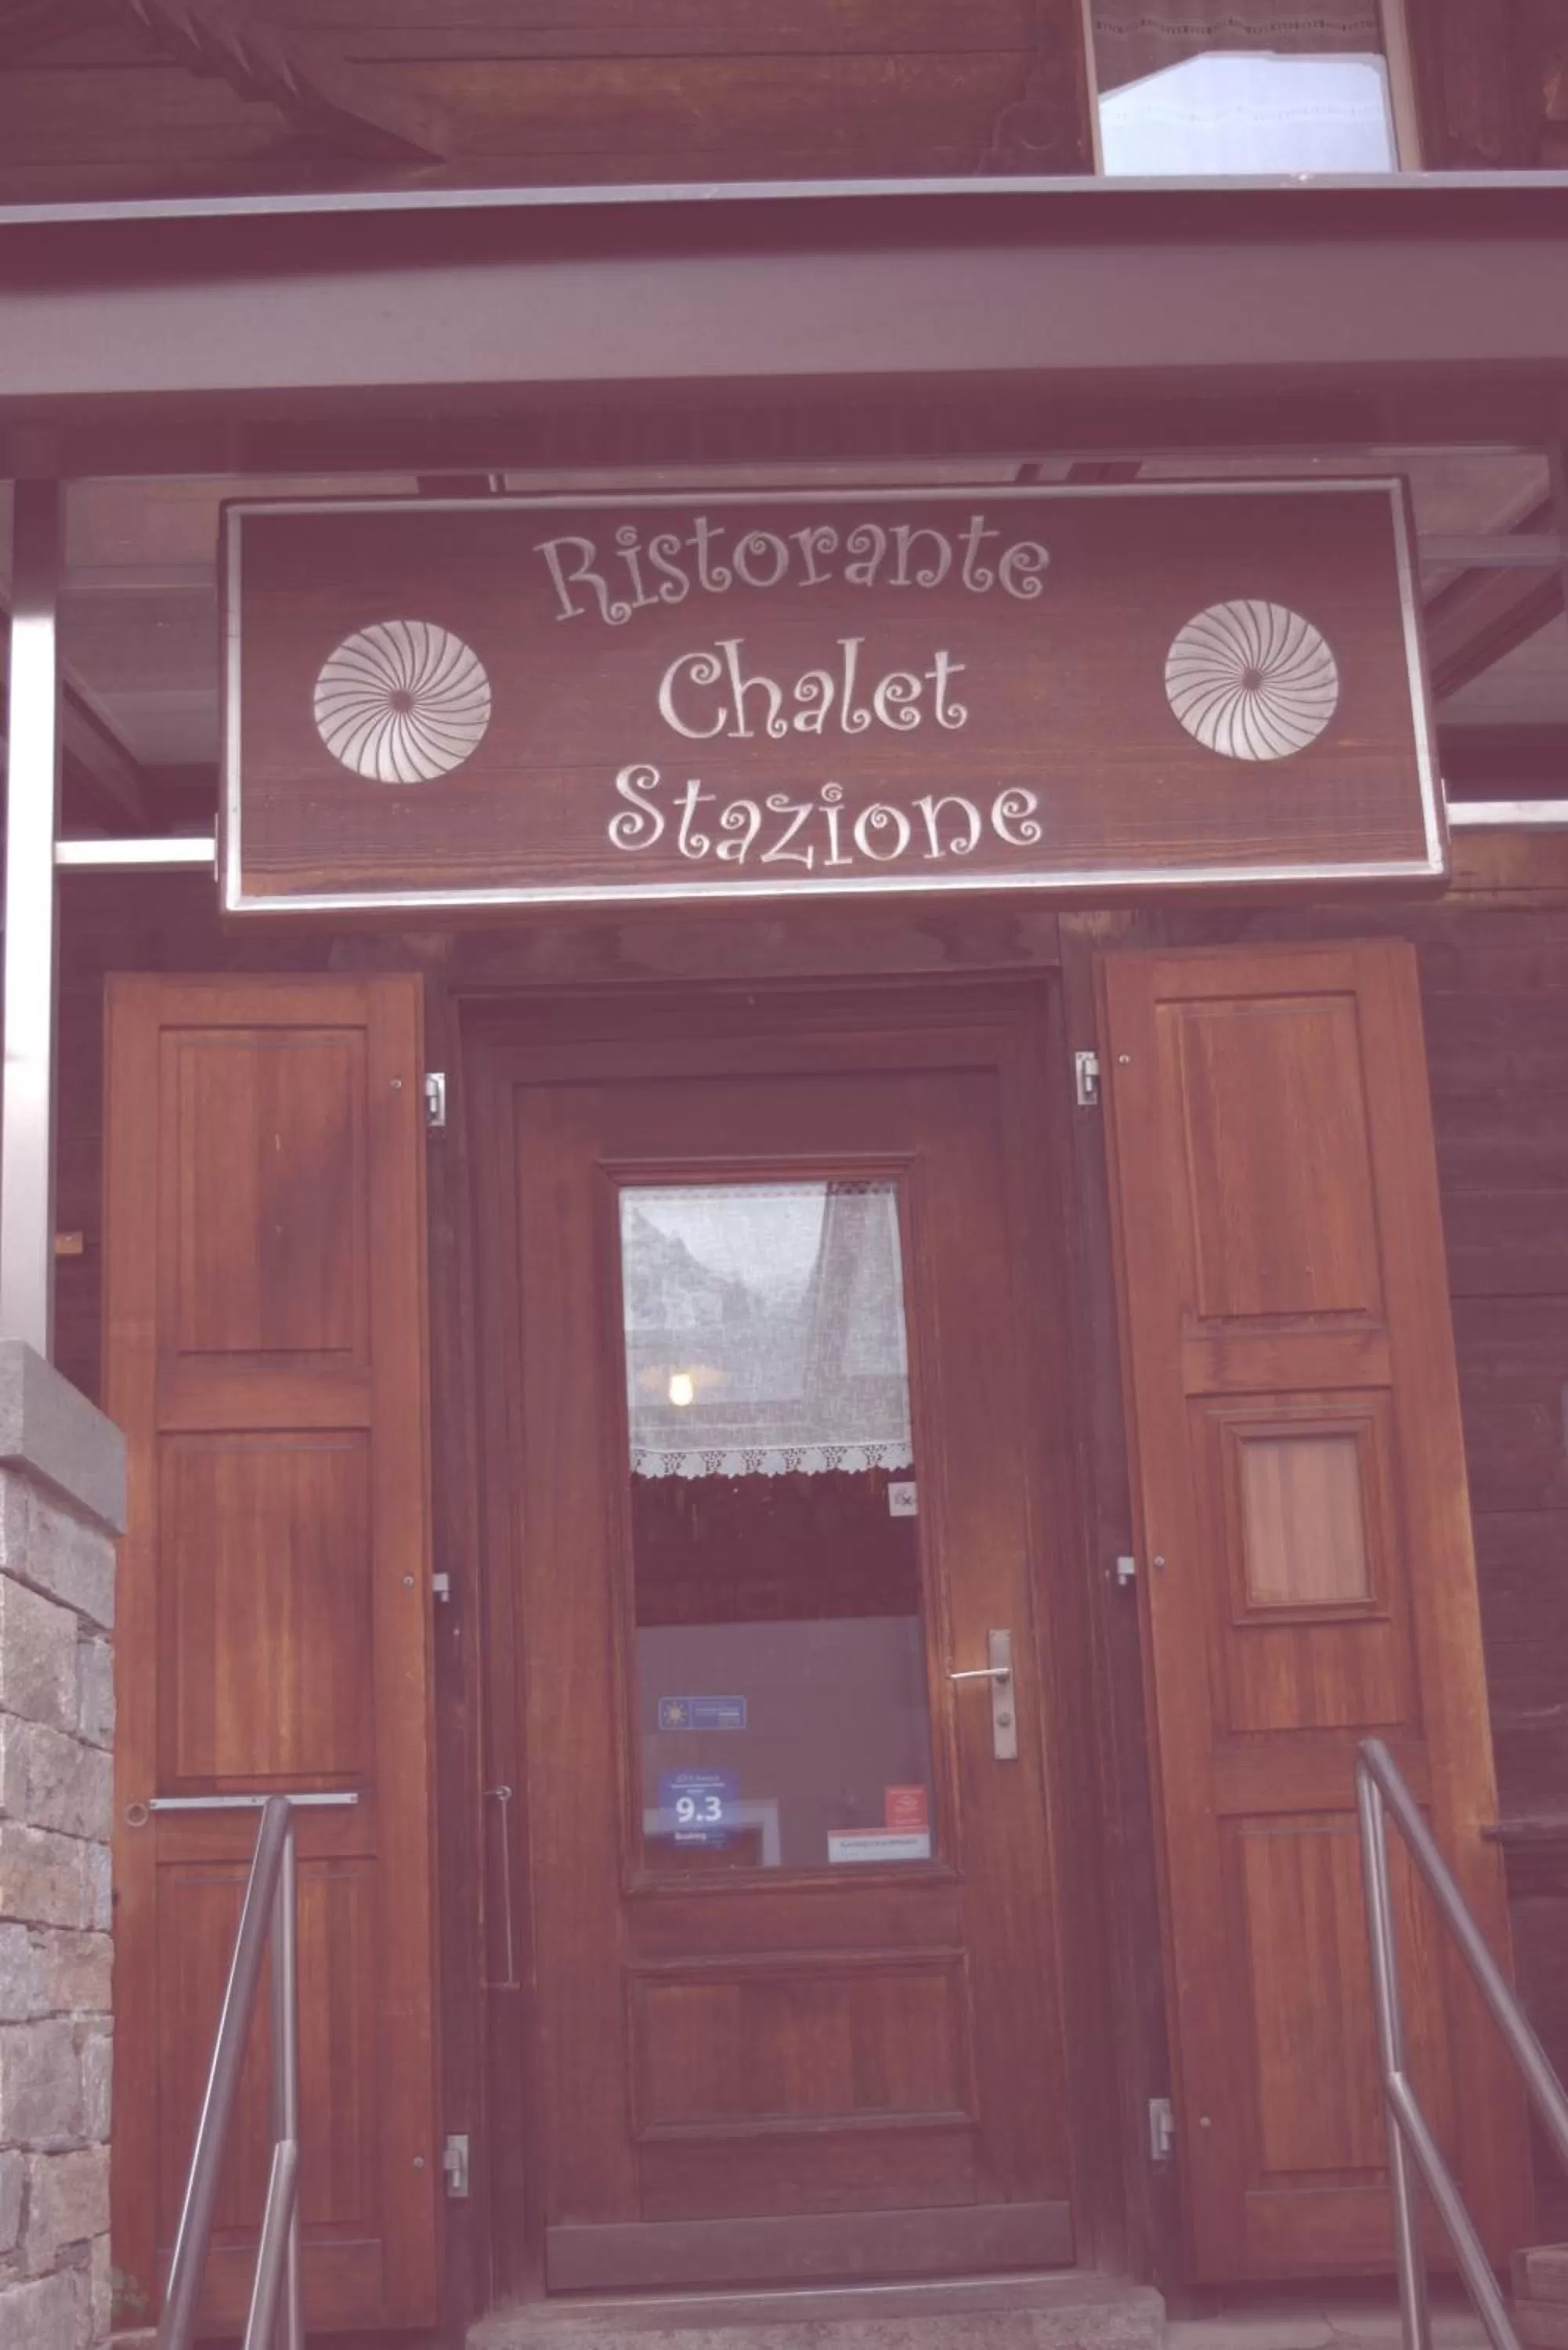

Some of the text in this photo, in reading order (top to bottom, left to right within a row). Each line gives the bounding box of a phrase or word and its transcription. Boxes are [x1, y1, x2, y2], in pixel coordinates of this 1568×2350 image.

[533, 515, 1050, 626] Ristorante
[657, 637, 968, 739] Chalet
[606, 763, 1042, 869] Stazione
[676, 1796, 722, 1824] 9.3
